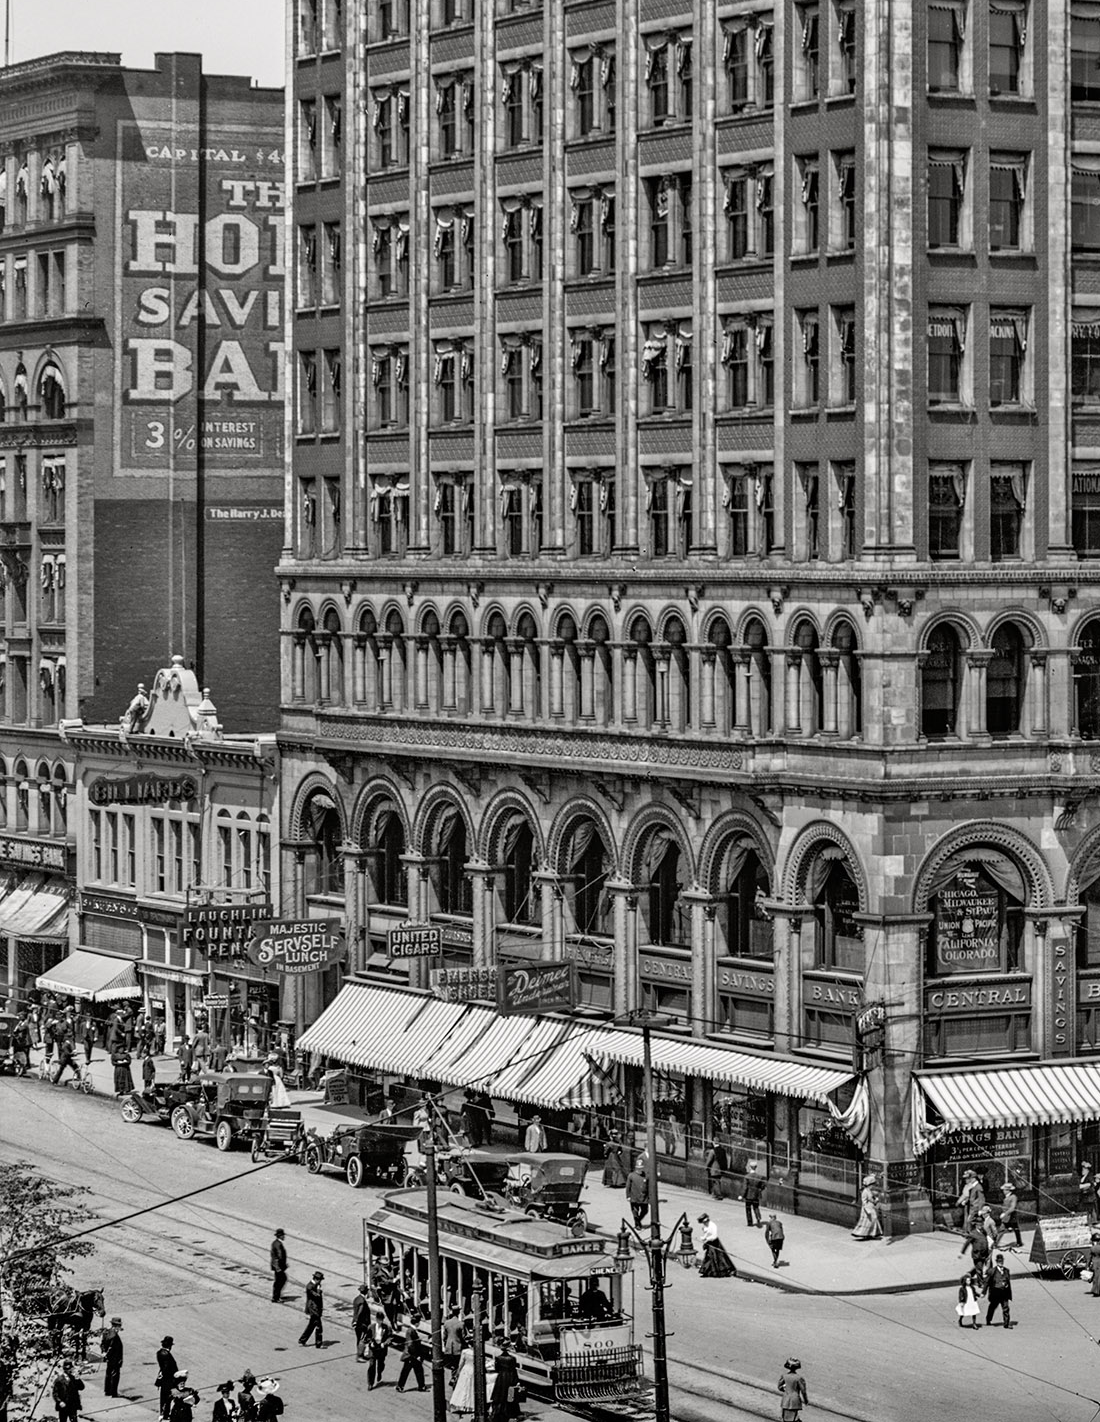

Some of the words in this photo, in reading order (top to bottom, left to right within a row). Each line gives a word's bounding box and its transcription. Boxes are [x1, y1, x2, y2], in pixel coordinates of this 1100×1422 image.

[145, 145, 246, 162] CAPITAL
[201, 421, 256, 433] INTEREST
[214, 437, 256, 448] SAVINGS
[210, 508, 229, 518] The
[230, 508, 260, 520] Harry
[94, 779, 194, 801] BILLIARDS
[943, 898, 995, 908] MILWAUKEE
[957, 908, 964, 916] &
[270, 922, 327, 935] MAJESTIC
[938, 921, 960, 930] UNION
[974, 919, 997, 928] PACIFIC
[392, 929, 438, 943] UNITED
[391, 942, 440, 957] CIGARS
[285, 950, 328, 964] LUNCH
[284, 962, 320, 973] BASEMENT
[721, 971, 775, 993] SAVINGS
[812, 984, 858, 1006] BANK
[1055, 944, 1067, 1046] SAVINGS
[931, 986, 1027, 1009] CENTRAL
[939, 1132, 992, 1146] SAVINGS
[996, 1128, 1030, 1141] BANK
[994, 1149, 1020, 1157] DEPOSITS
[562, 1243, 601, 1254] BAKER
